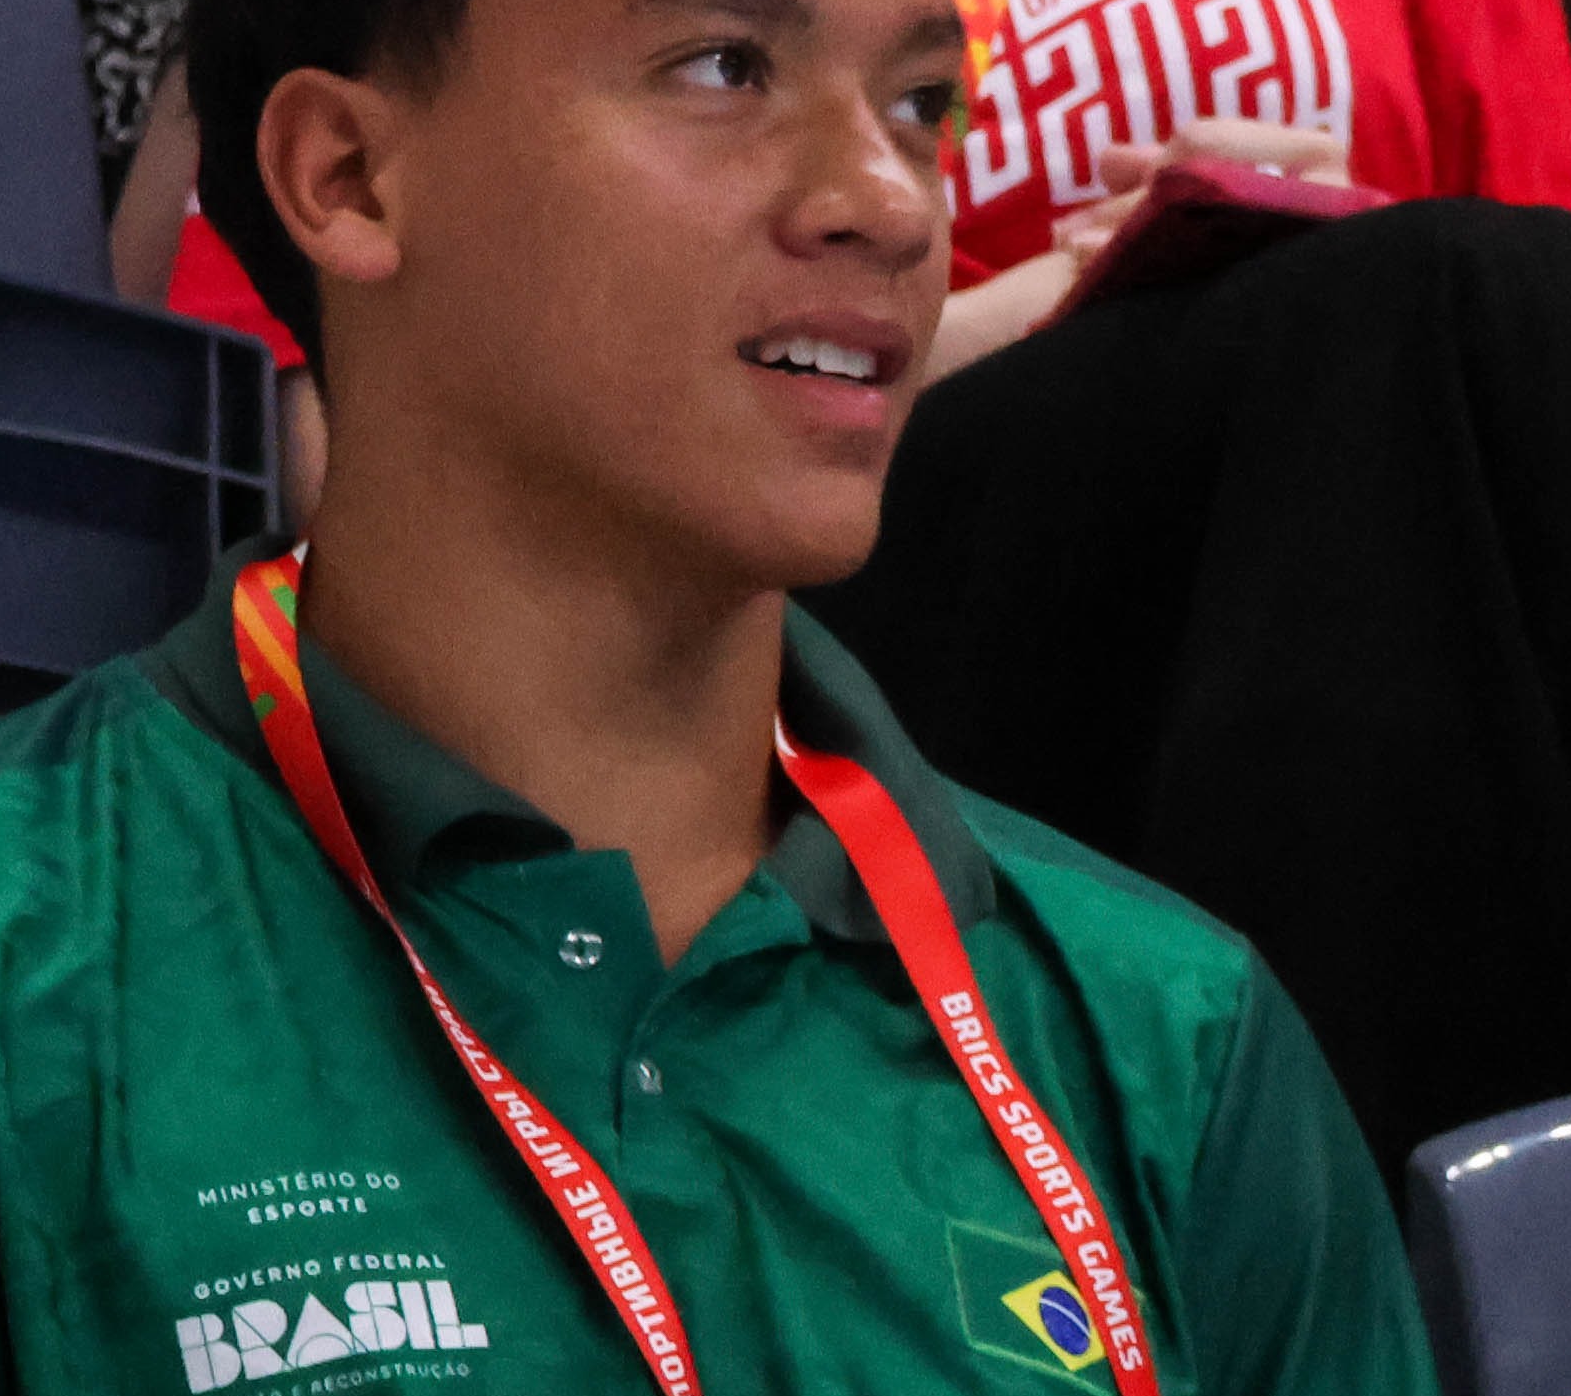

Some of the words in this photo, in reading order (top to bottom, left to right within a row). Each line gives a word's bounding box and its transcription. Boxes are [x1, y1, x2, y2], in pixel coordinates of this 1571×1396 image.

[493, 1089, 582, 1179] ИГРЫ
[197, 1170, 357, 1207] MINISTÉRIO
[364, 1171, 402, 1190] DO
[246, 1196, 369, 1225] ESPORTE
[940, 990, 1015, 1097] BRICS
[997, 1099, 1097, 1234] SPORTS
[1077, 1239, 1144, 1373] GAMES
[193, 1259, 323, 1300] GOVERNO
[331, 1252, 447, 1271] FEDERAL
[175, 1279, 491, 1395] BRASIL
